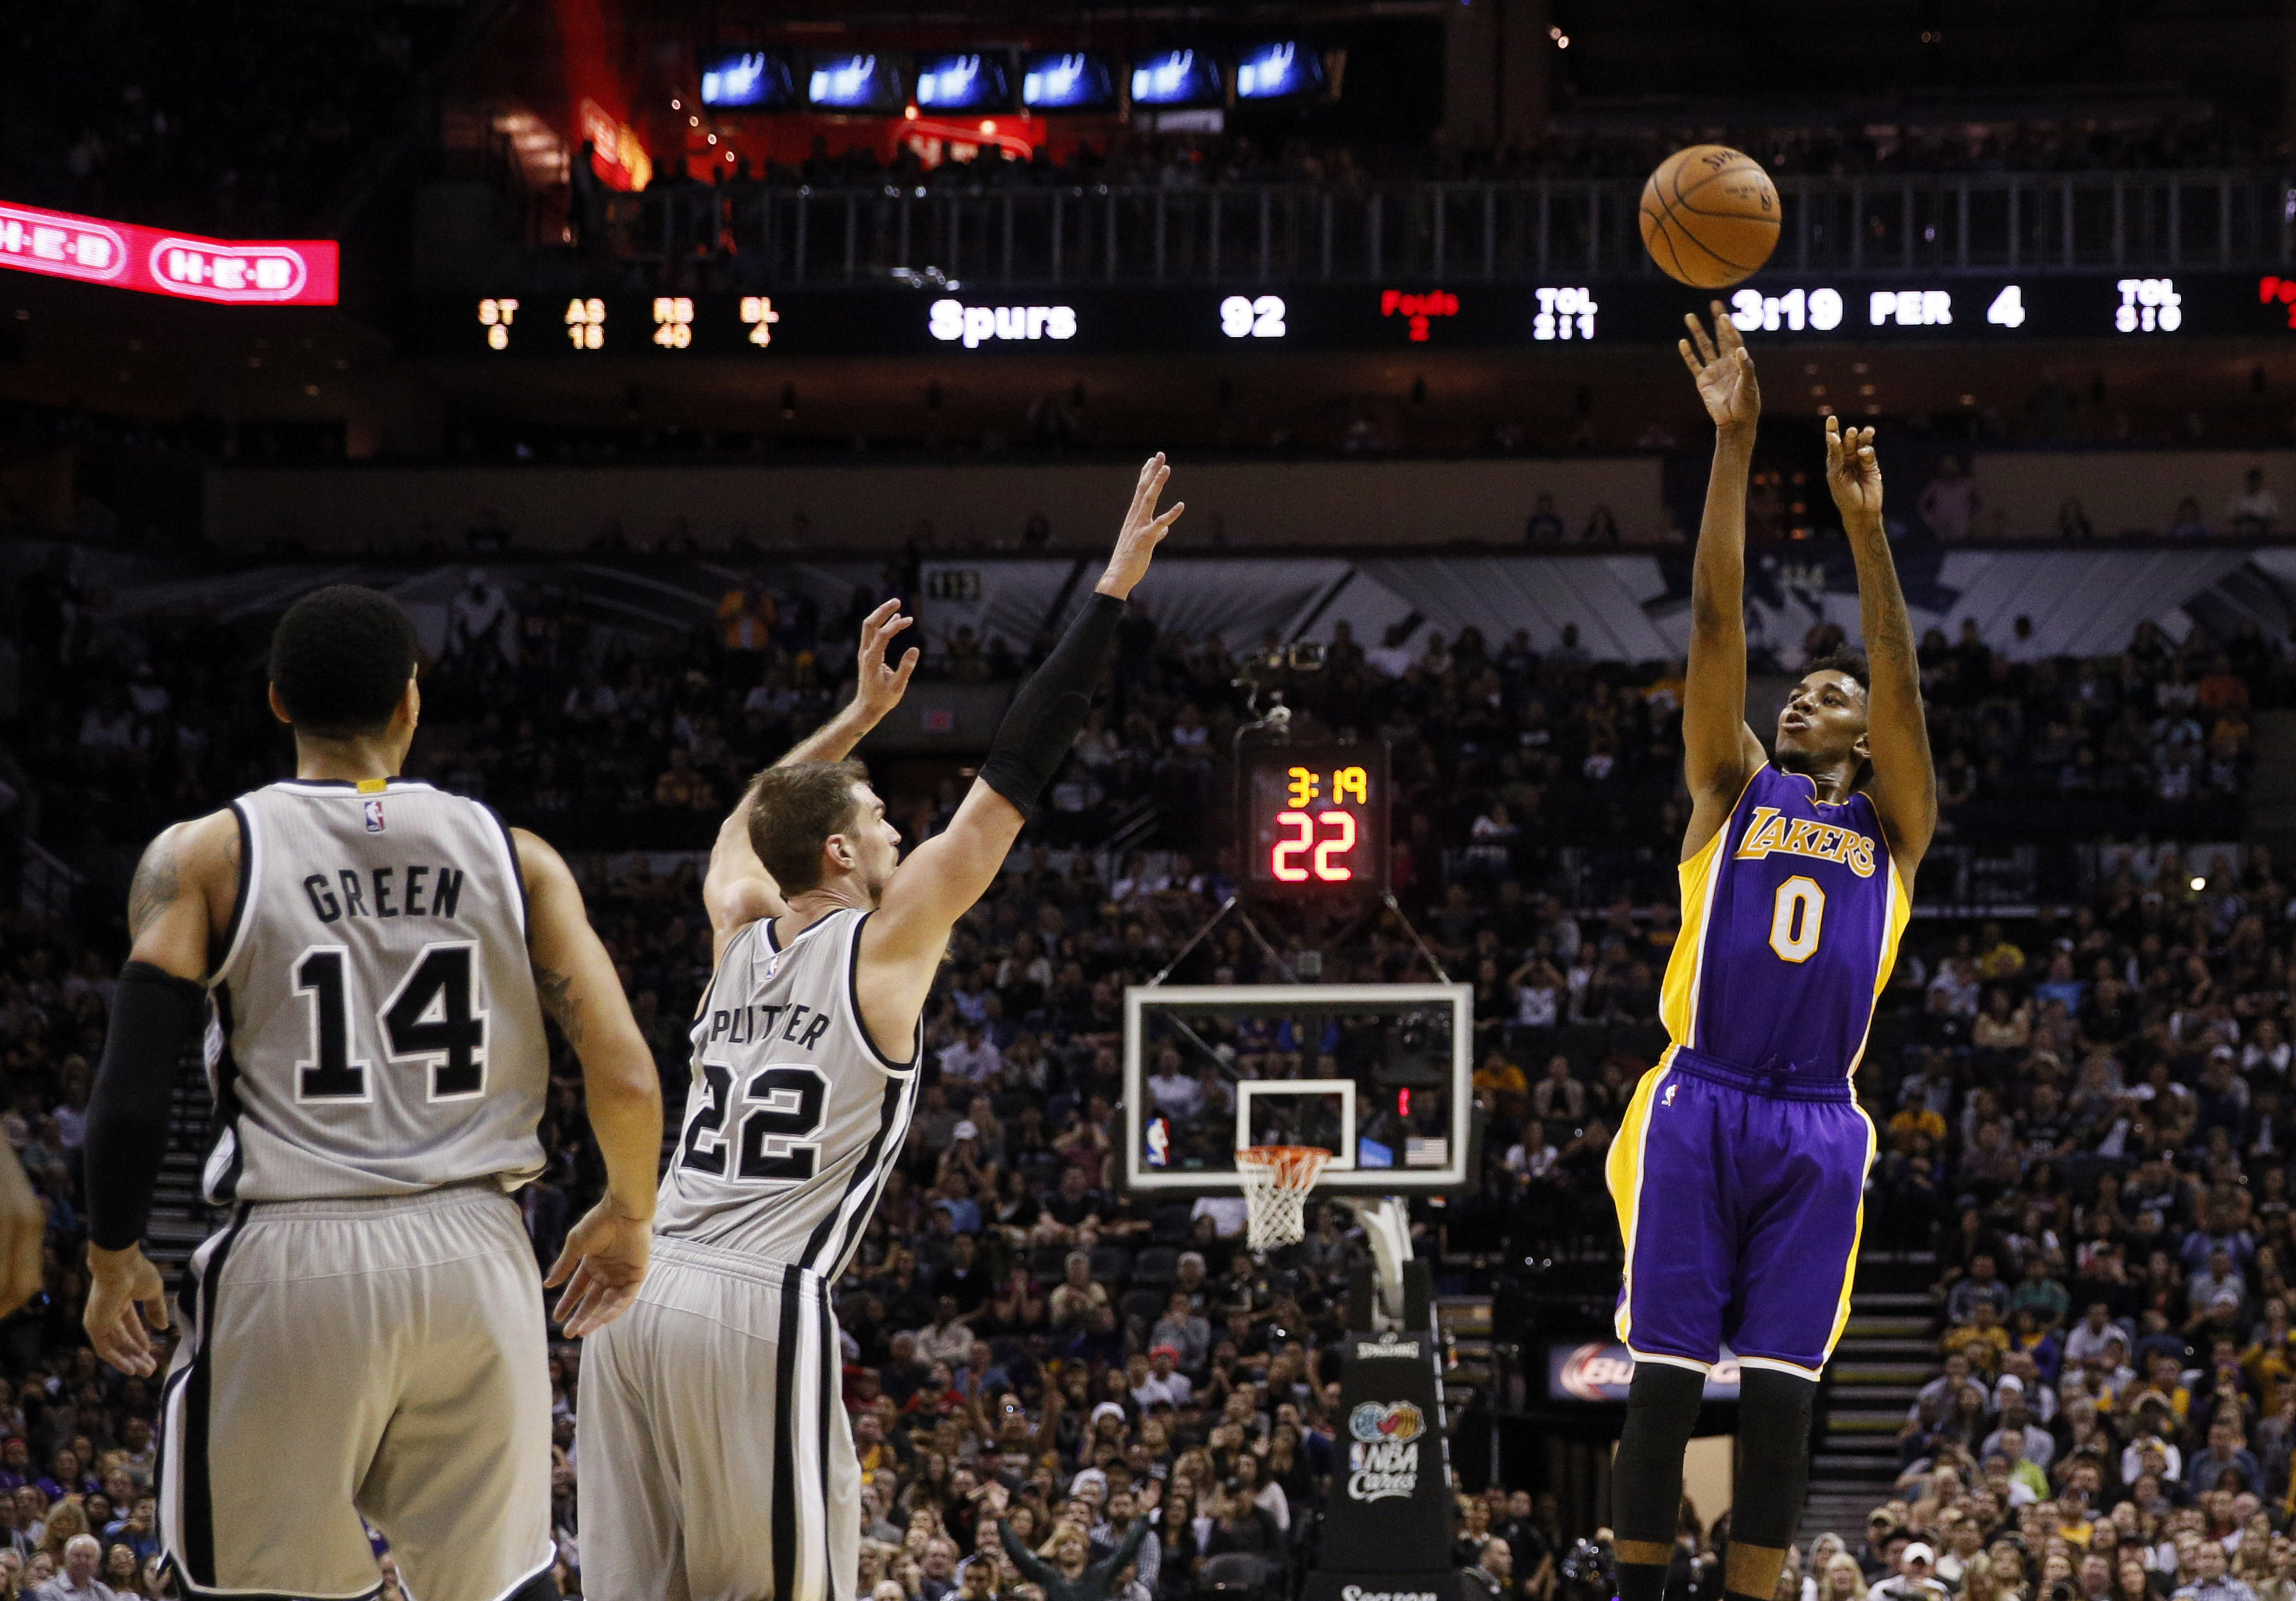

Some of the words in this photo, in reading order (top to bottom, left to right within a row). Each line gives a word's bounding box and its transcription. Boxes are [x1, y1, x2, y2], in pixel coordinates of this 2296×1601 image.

[1536, 287, 1598, 314] TOL
[1870, 291, 1952, 325] PER
[1988, 286, 2025, 327] 4
[2117, 279, 2181, 305] TOL
[929, 300, 1076, 348] Spurs
[1221, 296, 1285, 337] 92
[1288, 766, 1367, 808] 3:19
[1272, 811, 1356, 881] 22
[1733, 807, 1876, 878] LAKERS
[304, 866, 463, 923] GREEN
[1769, 875, 1826, 963] 0
[291, 939, 490, 1104] 14
[678, 1059, 833, 1184] 22
